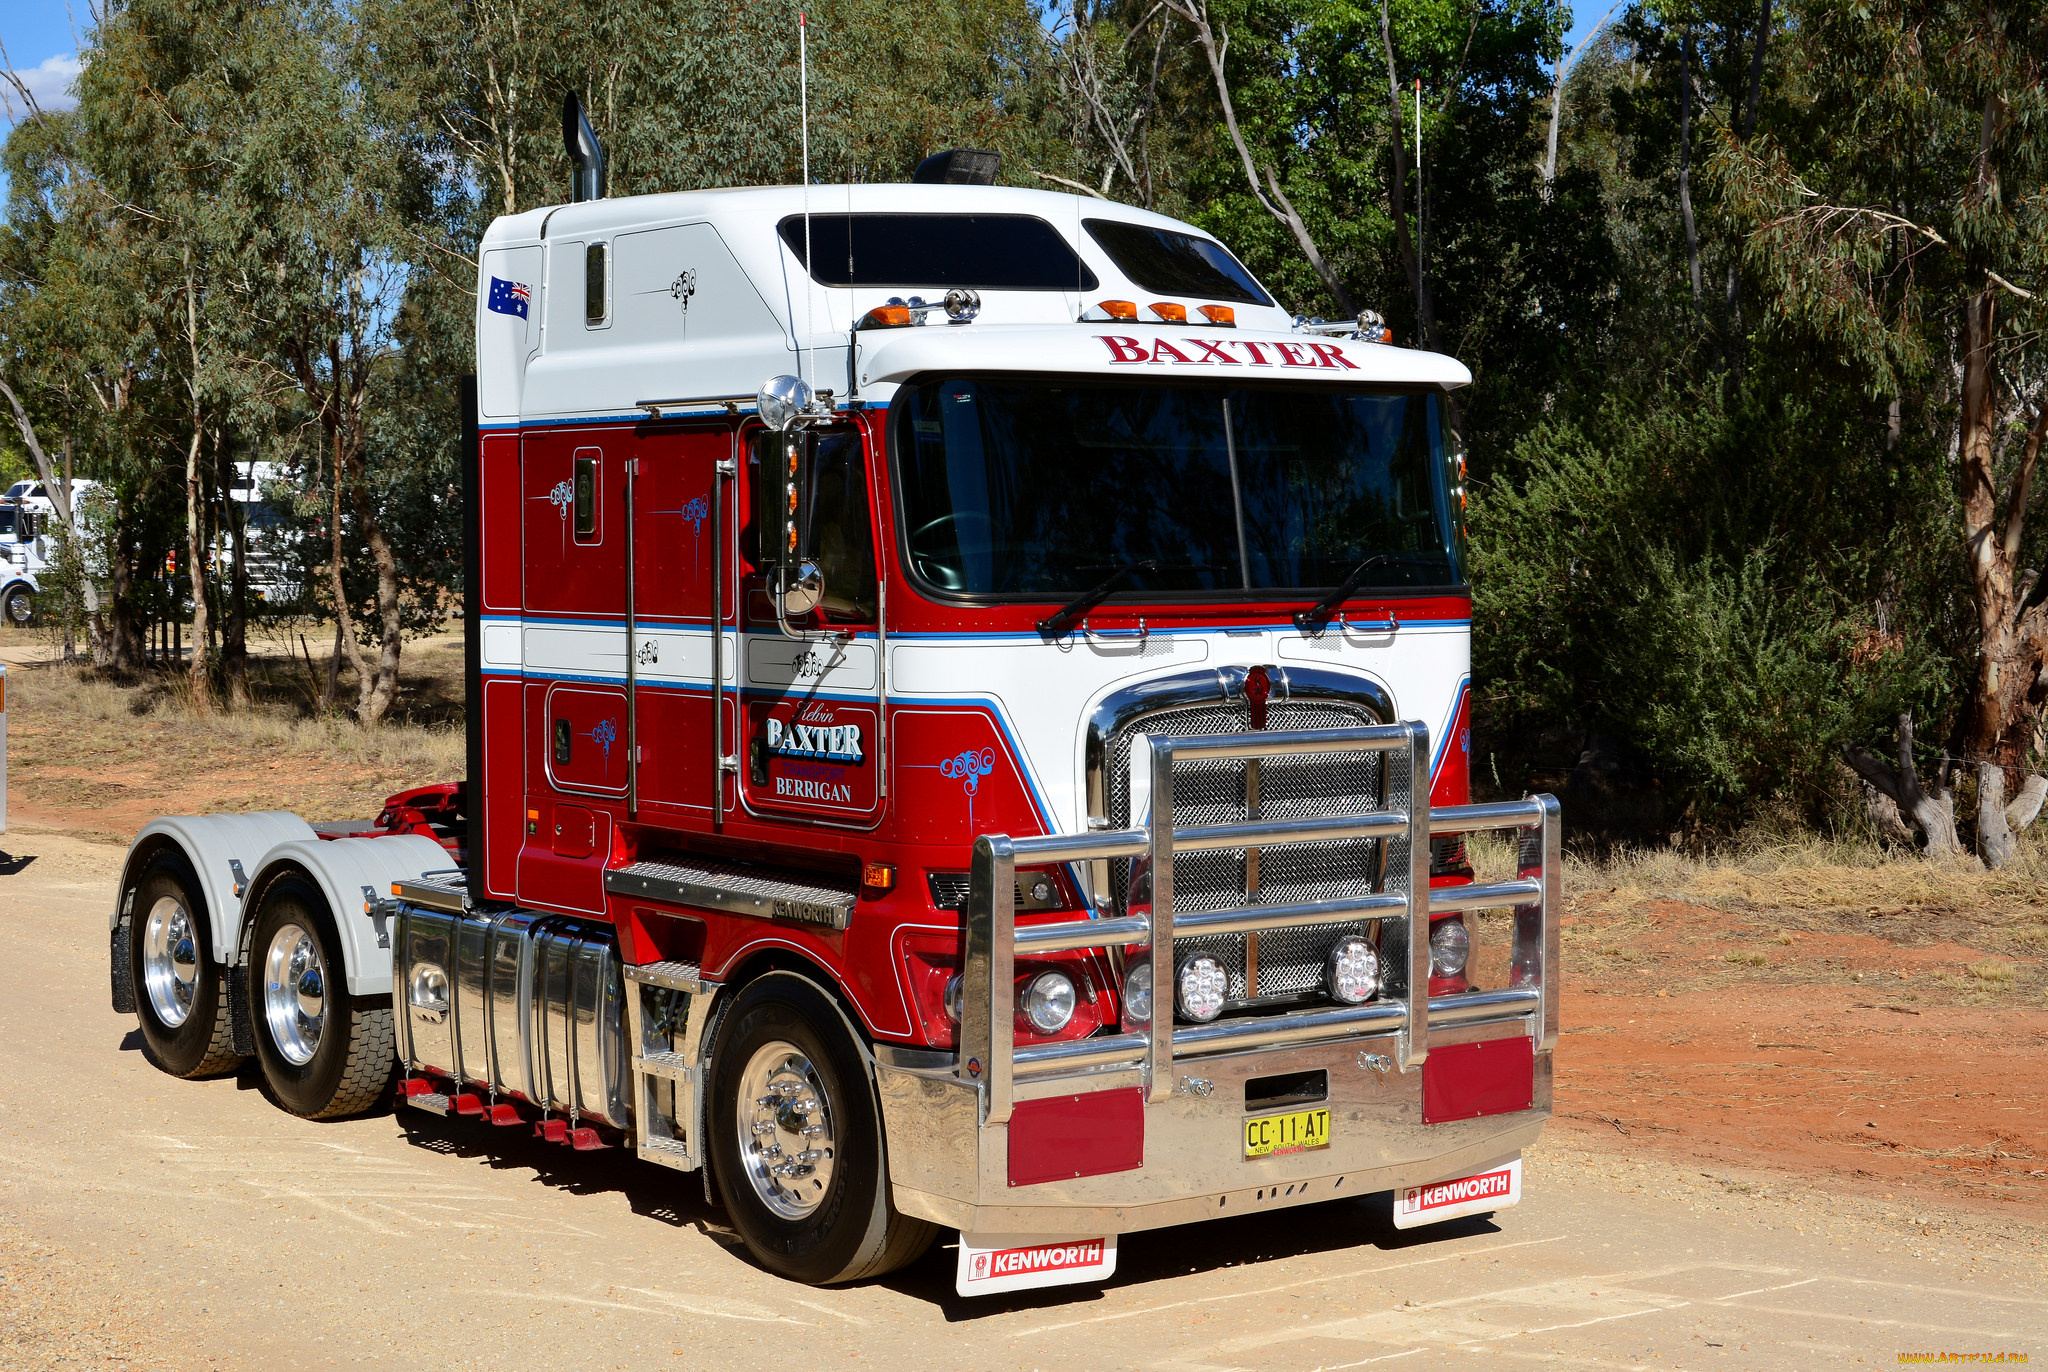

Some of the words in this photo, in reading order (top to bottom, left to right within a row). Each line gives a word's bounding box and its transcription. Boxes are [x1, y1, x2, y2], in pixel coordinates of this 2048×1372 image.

[1092, 335, 1361, 371] BAXTER
[792, 700, 835, 723] Kelvin
[766, 717, 865, 763] BAXTER
[782, 762, 846, 783] TRANSPORT
[776, 777, 851, 803] BERRIGAN
[772, 900, 833, 925] KENWORTH
[1254, 1146, 1270, 1154] NEW
[1298, 1138, 1320, 1146] WALES
[1273, 1145, 1305, 1156] KENWORTH
[1423, 1174, 1508, 1206] KENWORTH
[994, 1243, 1101, 1273] KENWORTH
